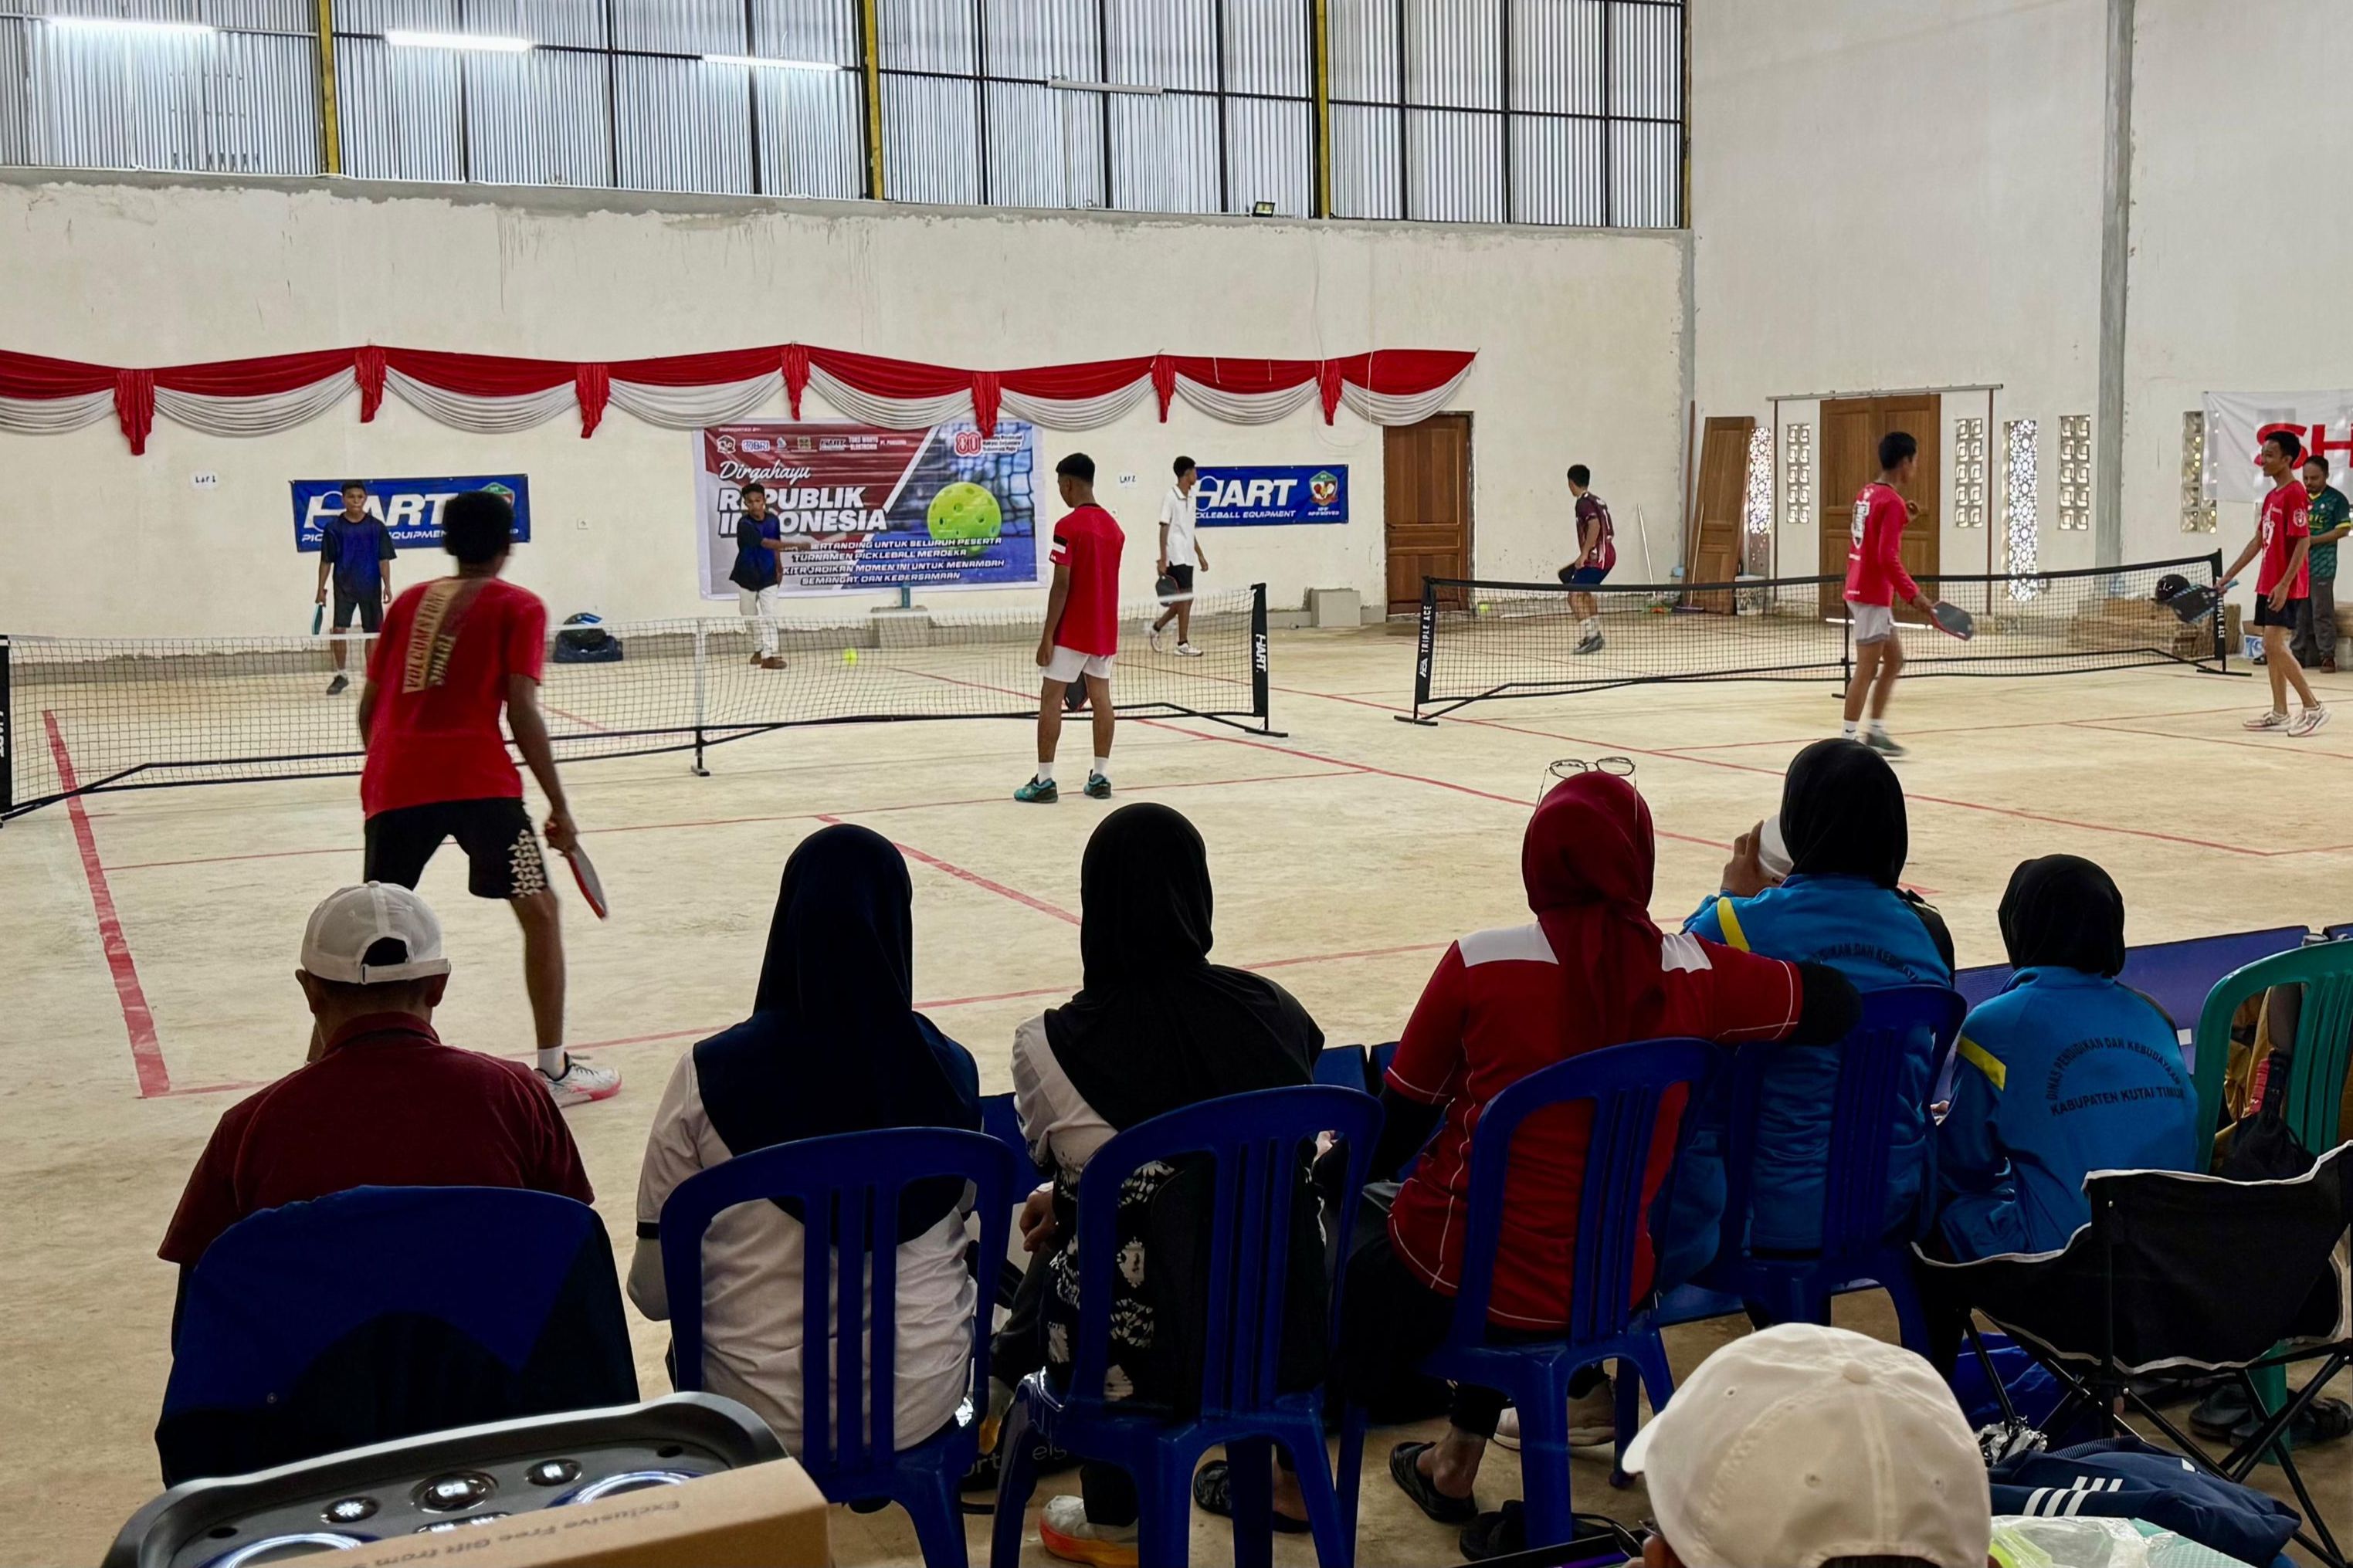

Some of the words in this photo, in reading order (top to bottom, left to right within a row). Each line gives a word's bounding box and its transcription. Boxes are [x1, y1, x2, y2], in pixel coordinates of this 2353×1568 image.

[956, 432, 982, 455] 80
[720, 459, 811, 486] Dirgahayu
[718, 486, 866, 511] RPUBLIK
[1195, 476, 1297, 510] HART
[719, 508, 888, 535] IONESIA
[1195, 511, 1240, 520] CKLEBALL
[1243, 510, 1296, 519] EQUIPMENT
[388, 530, 448, 540] QUIPMEN
[811, 541, 873, 550] ERTANDING
[874, 540, 908, 549] UNTUK
[910, 539, 956, 547] SELURUH
[958, 537, 1002, 546] PESERTA
[794, 551, 853, 562] TURNAMEN
[855, 550, 916, 559] PICKLEBALL
[917, 549, 967, 557] MERDEKA
[783, 566, 806, 575] KITA
[808, 564, 853, 574] JADIKAN
[855, 563, 895, 572] MOMEN
[946, 559, 1005, 569] MENAMBAH
[801, 574, 859, 585] SEMANGAT
[884, 572, 961, 581] KEBERSAMAAN
[1423, 605, 1432, 621] ACE
[1421, 624, 1430, 653] TRIPLE
[1256, 633, 1266, 673] HART
[2046, 1068, 2063, 1100] DINAS
[2104, 1037, 2124, 1049] DAN
[2050, 1091, 2119, 1116] KABUPATEN
[2121, 1087, 2155, 1102] KUTAI
[564, 1500, 680, 1529] Exclusive
[499, 1526, 556, 1542] Free
[446, 1539, 490, 1554] Gift
[375, 1549, 438, 1566] from
